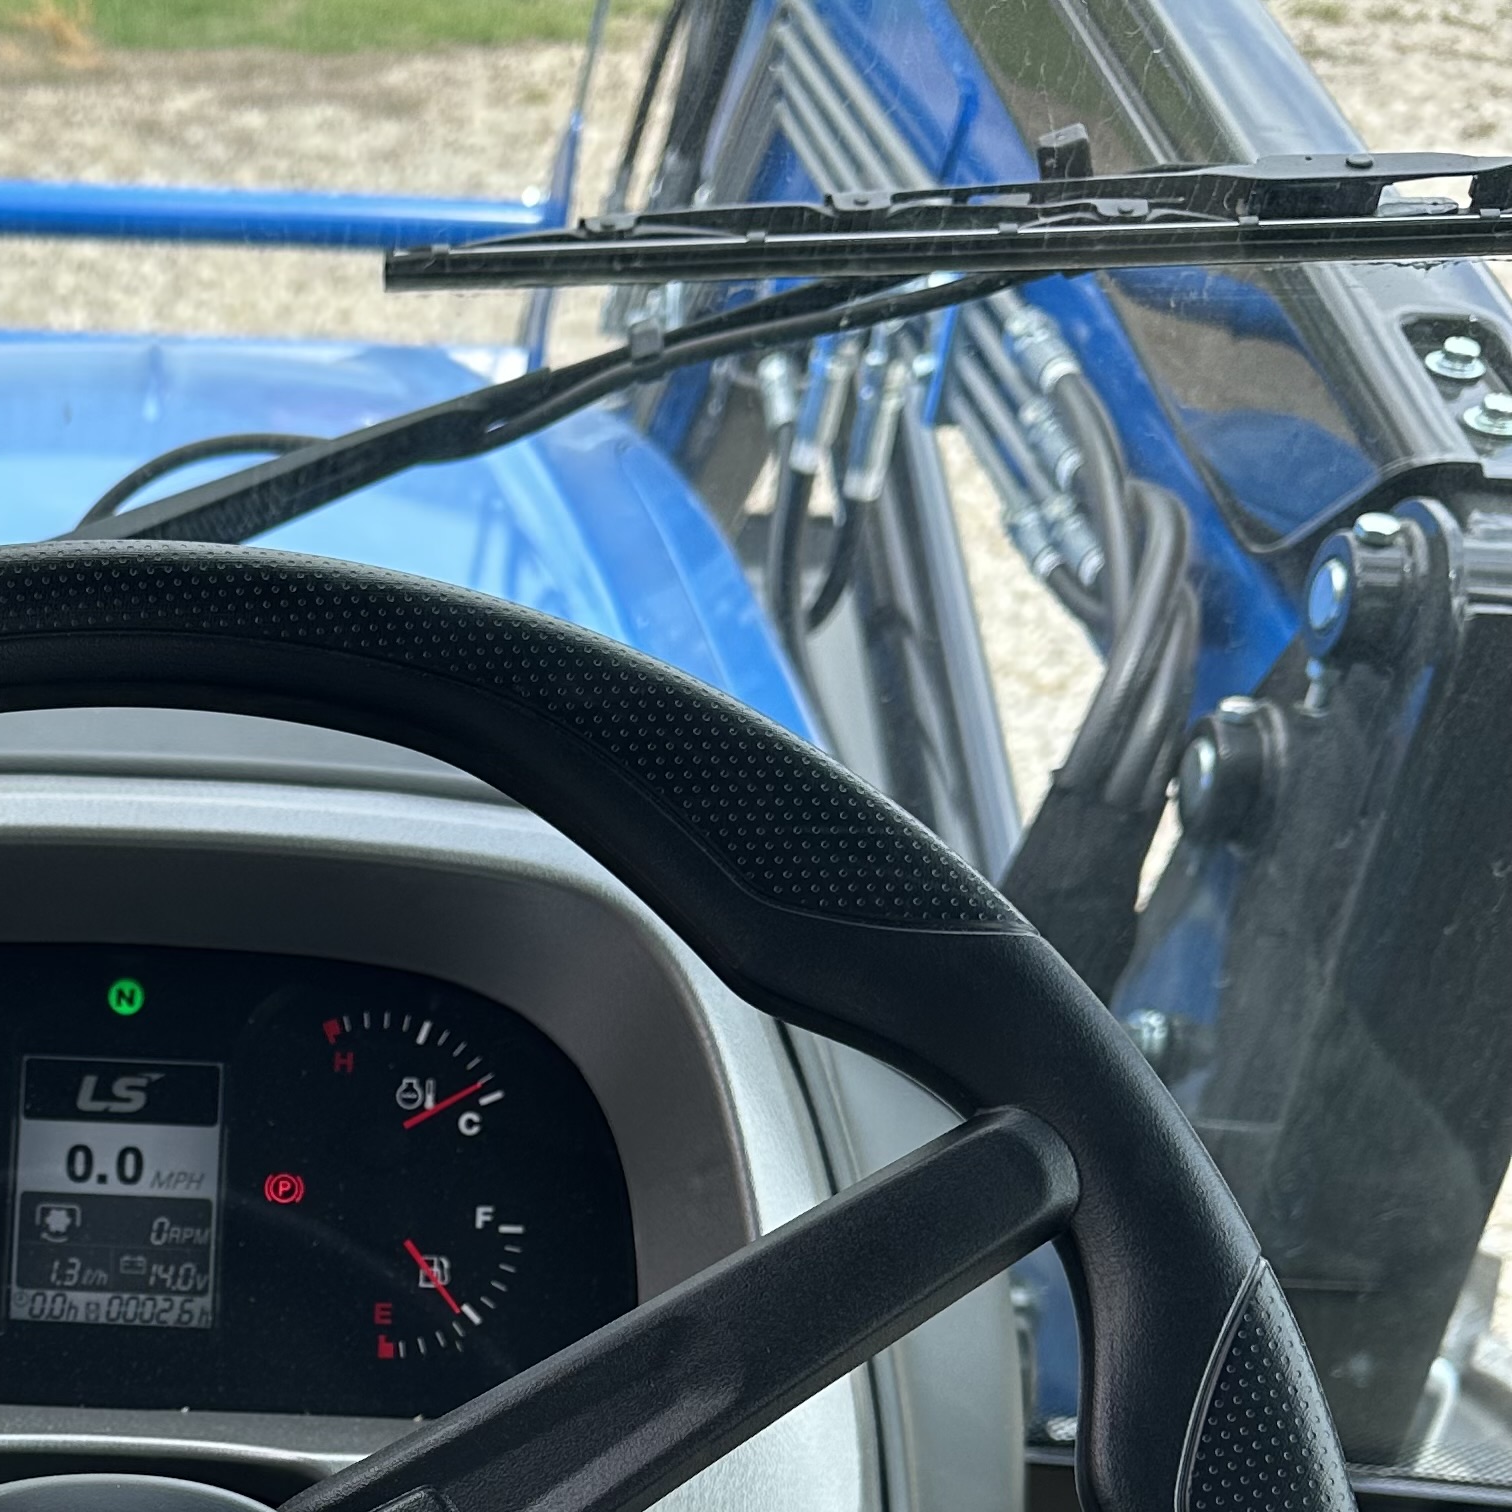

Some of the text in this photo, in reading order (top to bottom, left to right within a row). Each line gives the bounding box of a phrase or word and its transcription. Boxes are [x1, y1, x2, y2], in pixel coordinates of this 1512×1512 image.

[116, 988, 135, 1009] N
[334, 1052, 354, 1073] H
[76, 1074, 150, 1113] LS
[457, 1111, 481, 1136] C
[65, 1144, 206, 1191] 0.0 MPH
[475, 1206, 494, 1230] F
[374, 1303, 393, 1325] E
